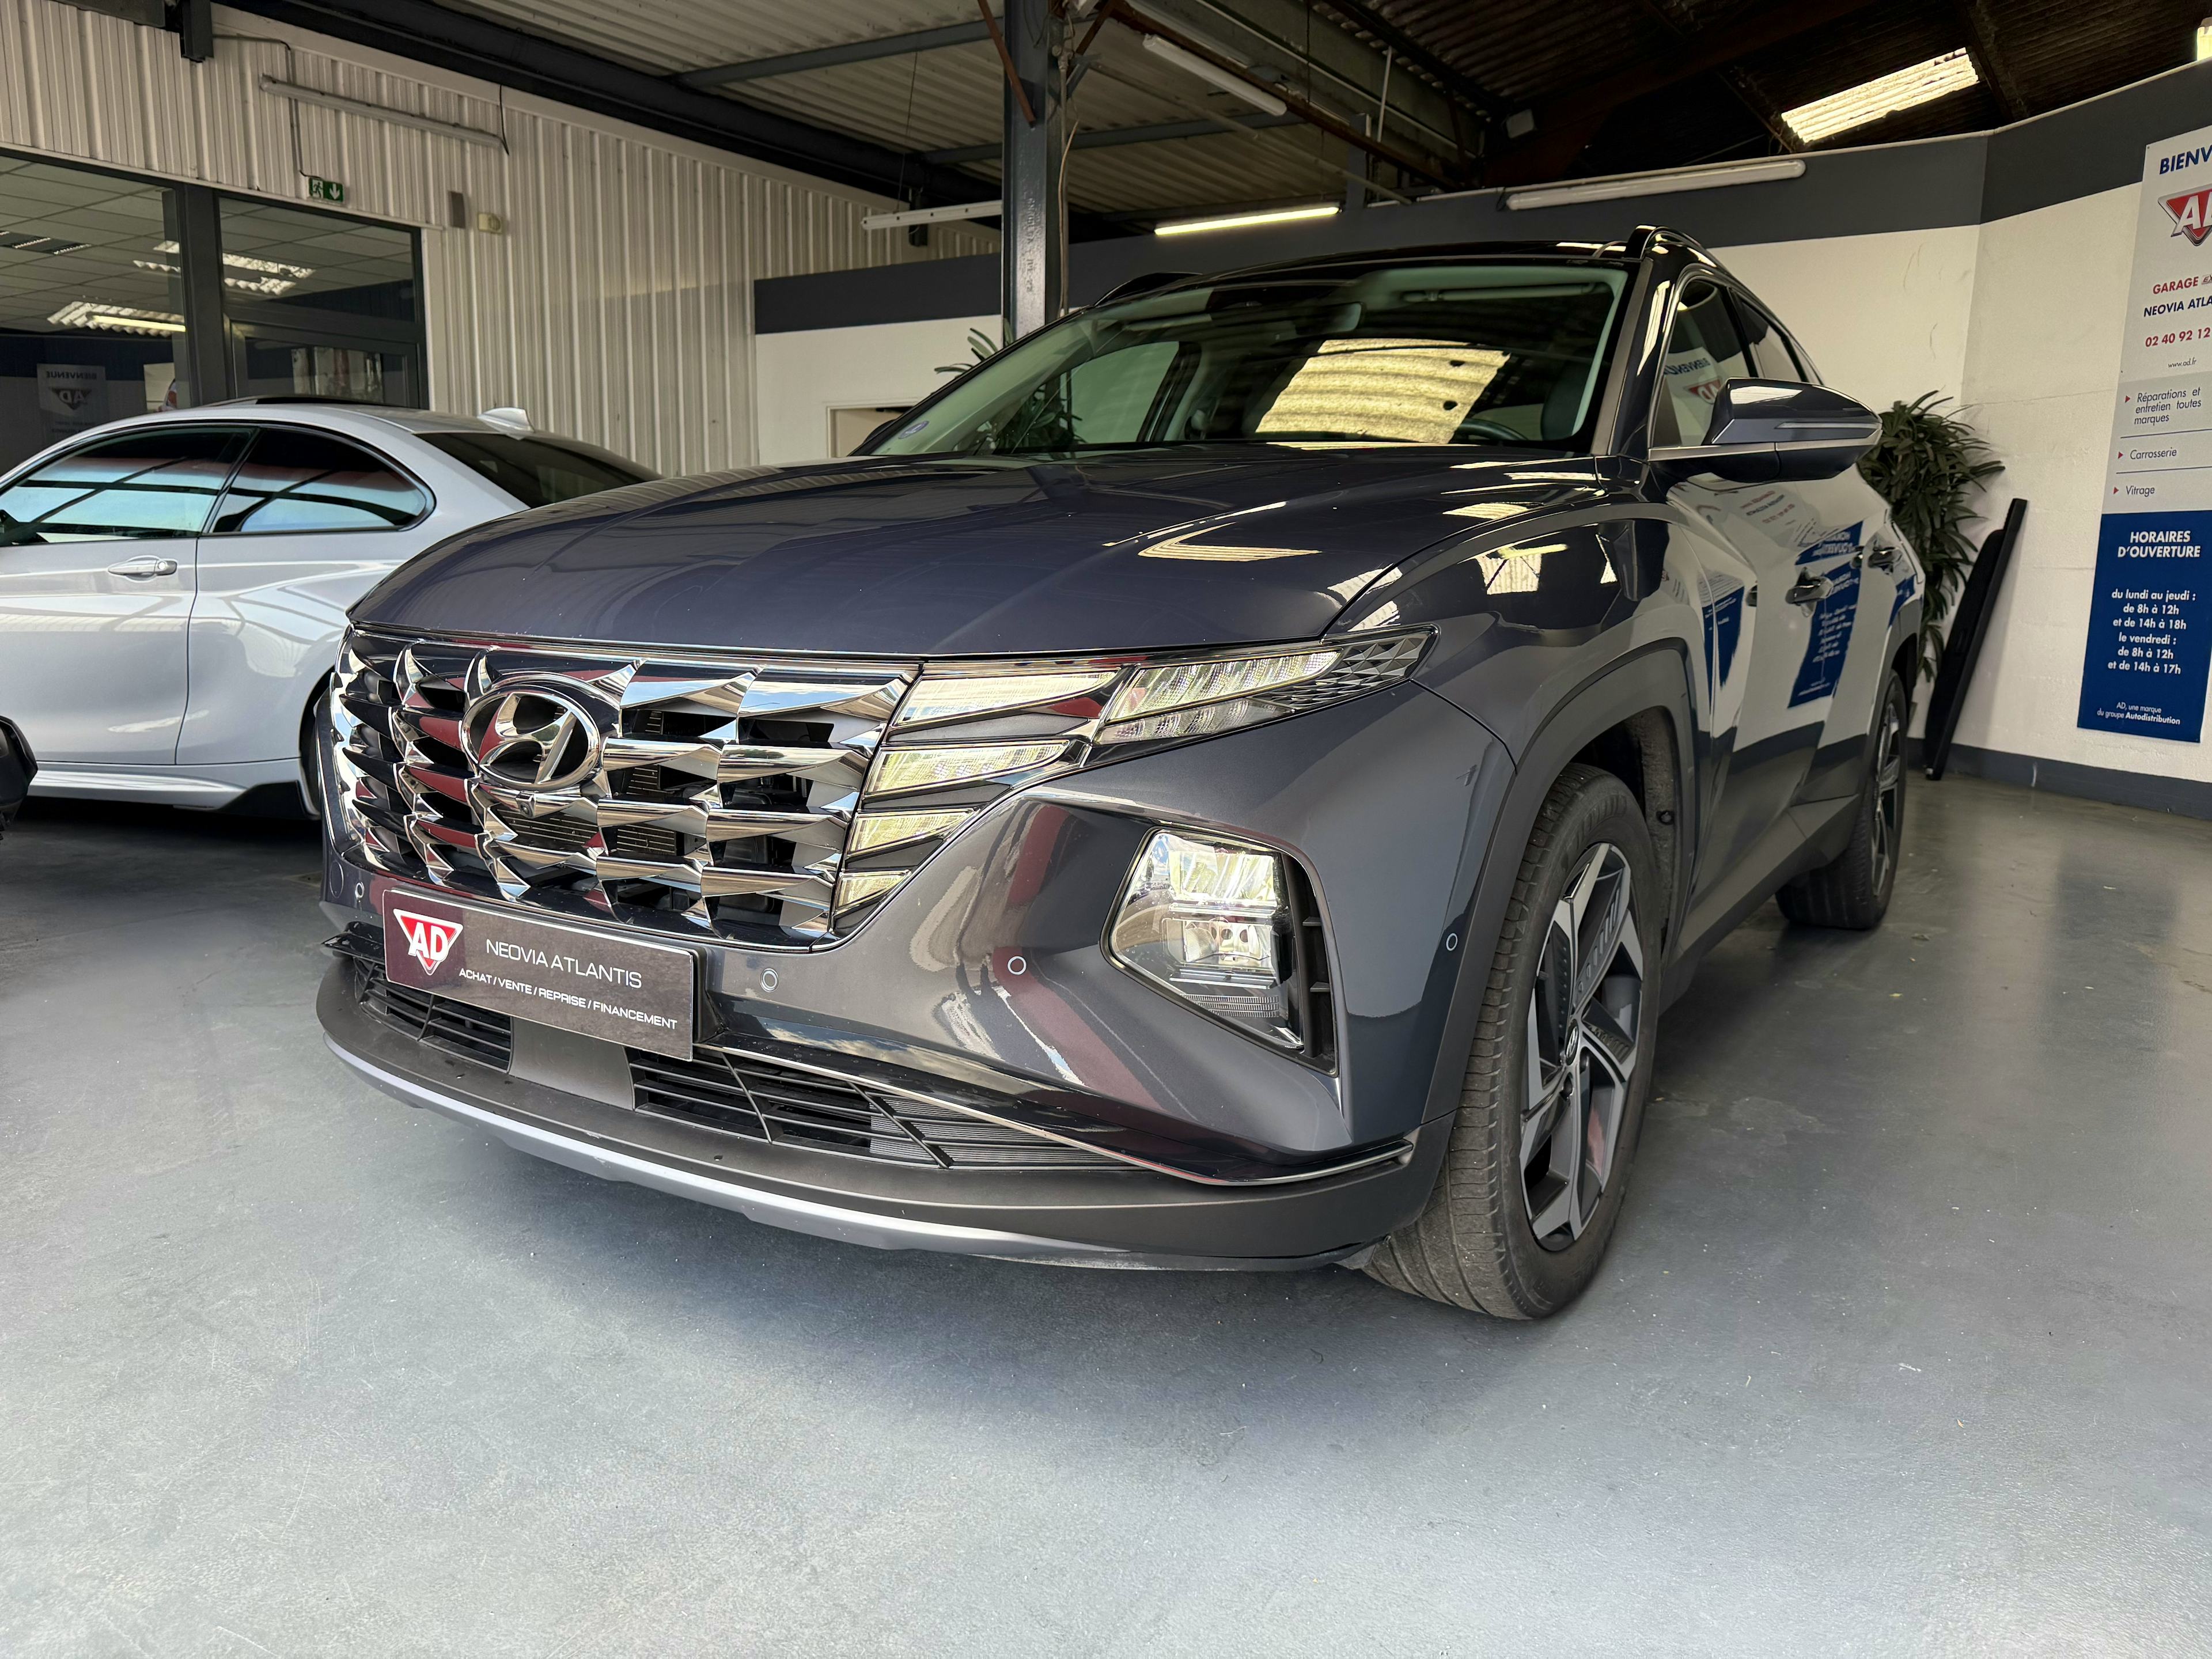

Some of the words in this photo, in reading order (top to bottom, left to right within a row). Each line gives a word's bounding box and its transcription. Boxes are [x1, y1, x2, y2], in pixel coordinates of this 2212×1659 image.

[2160, 145, 2212, 175] BIENV
[2153, 276, 2199, 294] GARAGE
[2143, 301, 2184, 317] NEOVIA
[2187, 295, 2212, 309] ATLA
[2145, 336, 2158, 347] 02
[2161, 333, 2175, 344] 40
[2179, 330, 2192, 342] 92
[2198, 327, 2210, 339] 12
[2168, 357, 2196, 368] www.ad.fr
[2137, 389, 2186, 406] Réparations
[2192, 387, 2200, 396] et
[2135, 402, 2171, 414] entretien
[2177, 399, 2202, 410] toutes
[2134, 414, 2169, 426] marques
[2130, 447, 2177, 459] Carrosserie
[2126, 486, 2155, 497] Vitrage
[2130, 531, 2191, 543] HORAIRES
[2111, 588, 2123, 599] du
[2126, 589, 2149, 599] lundi
[2165, 590, 2190, 603] jeudi
[2123, 603, 2135, 613] de
[2137, 604, 2149, 613] 8h
[2152, 604, 2158, 613] à
[2162, 604, 2179, 615] 12h
[2113, 618, 2122, 626] et
[2124, 617, 2135, 627] de
[2139, 618, 2156, 628] 14h
[2158, 619, 2165, 628] à
[2169, 619, 2187, 630] 18h
[2119, 631, 2127, 642] le
[2129, 634, 2171, 645] vendredi
[2118, 646, 2129, 656] de
[2132, 647, 2143, 657] 8h
[2146, 648, 2153, 658] à
[2157, 649, 2174, 659] 12h
[2119, 660, 2130, 670] de
[2134, 661, 2150, 672] 14h
[2153, 663, 2160, 673] à
[2164, 664, 2181, 675] 17h
[2116, 702, 2127, 710] AD,
[2140, 706, 2162, 714] marque
[2097, 708, 2104, 716] du
[2105, 710, 2124, 719] groupe
[2125, 712, 2181, 725] Autodistribution
[408, 922, 449, 962] AD
[486, 938, 548, 968] NEOVIA
[551, 955, 642, 988] ATLANTIS
[459, 968, 493, 985] ACHAT
[498, 977, 532, 995] VENTE
[539, 987, 586, 1009] REPRISE
[593, 1001, 678, 1030] FINANCEMENT
